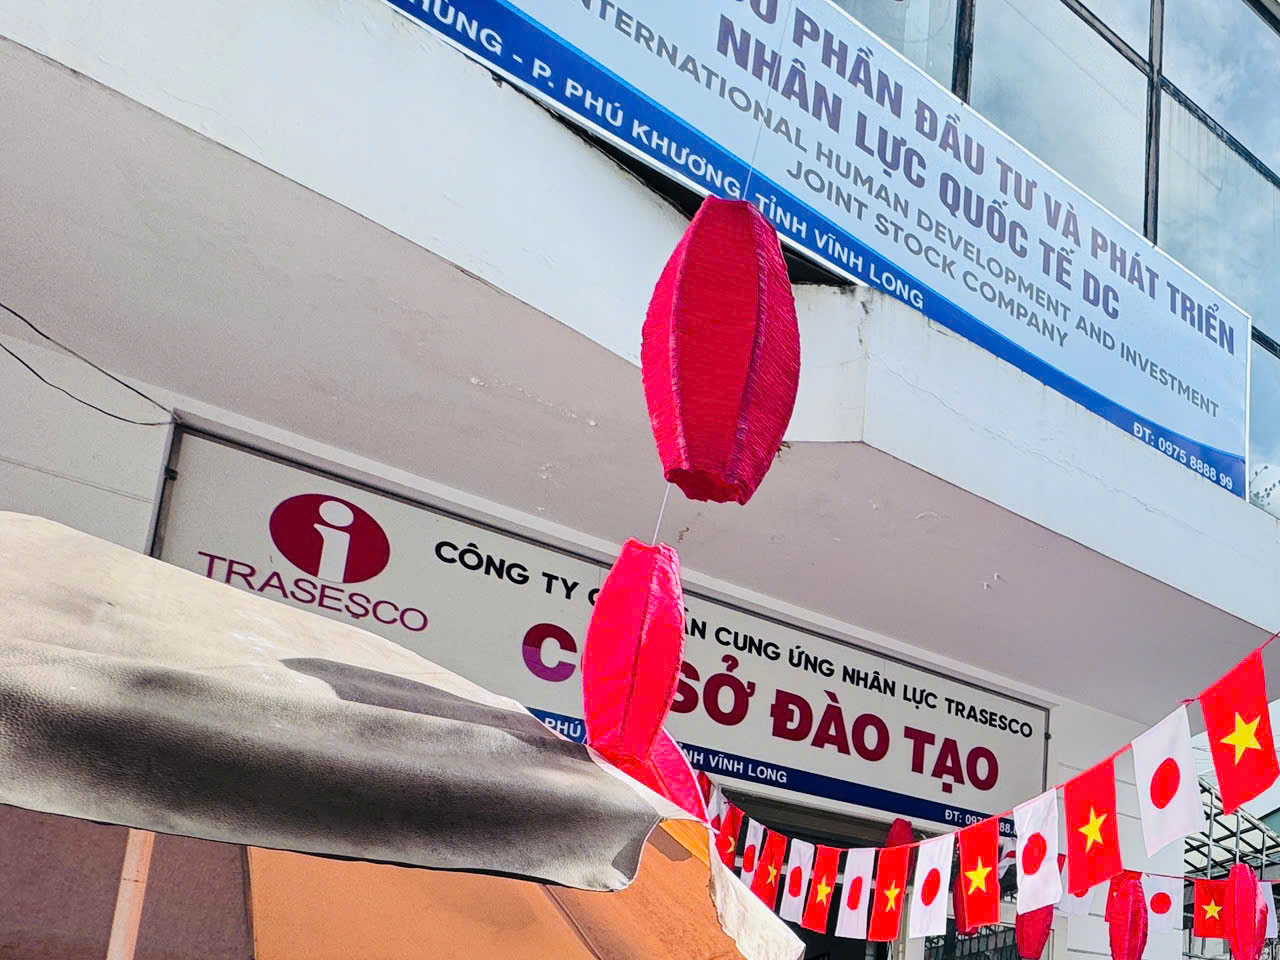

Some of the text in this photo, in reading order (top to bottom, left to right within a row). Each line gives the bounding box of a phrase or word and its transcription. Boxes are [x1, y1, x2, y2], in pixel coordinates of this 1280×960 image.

[532, 58, 554, 88] P.
[565, 78, 623, 126] PHÚ
[632, 119, 741, 199] KHƯƠNG
[755, 193, 806, 239] TỈNH
[815, 227, 863, 273] VĨNH
[870, 261, 924, 310] LONG
[581, 0, 1219, 418] TERNATIONAL HUMAN DEVELOPMENT AND INVESTMENT
[717, 14, 1120, 320] NHÂN LỰC QUỐC TẾ DC
[786, 161, 1069, 348] JOINT STOCK COMPANY
[792, 8, 1235, 356] PHẦN ĐẦU TƯ VÀ PHÁT TRIỂN
[1133, 422, 1233, 491] ĐT: 0975 8888 99
[435, 542, 530, 585] CÔNG
[542, 571, 579, 601] TY
[715, 627, 780, 662] CUNG
[788, 645, 835, 678] ỨNG
[842, 665, 895, 698] NHÂN
[903, 684, 937, 711] LỰC
[946, 698, 1033, 739] TRASESCO
[522, 622, 583, 682] C
[770, 688, 890, 762] ĐÀO
[904, 727, 999, 793] TẠO
[544, 716, 581, 738] PHÚ
[709, 750, 744, 774] VĨNH
[748, 759, 788, 783] LONG
[945, 809, 962, 823] ĐT:
